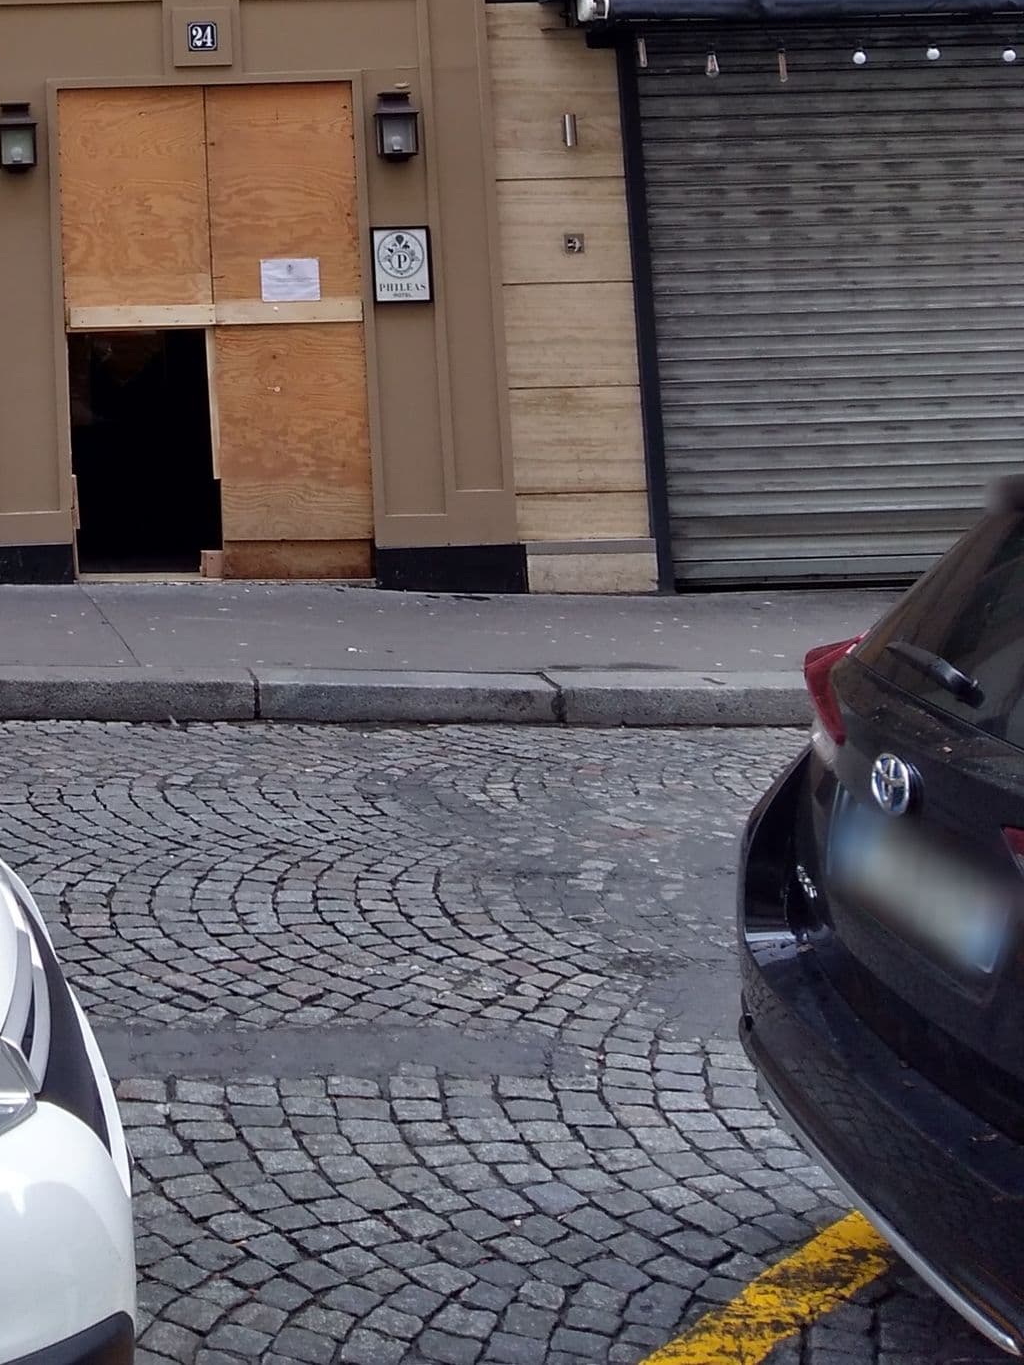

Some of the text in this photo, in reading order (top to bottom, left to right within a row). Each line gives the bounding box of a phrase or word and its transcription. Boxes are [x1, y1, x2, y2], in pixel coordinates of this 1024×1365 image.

[191, 25, 213, 47] 24
[397, 254, 408, 269] P
[379, 283, 426, 292] PHILEAS
